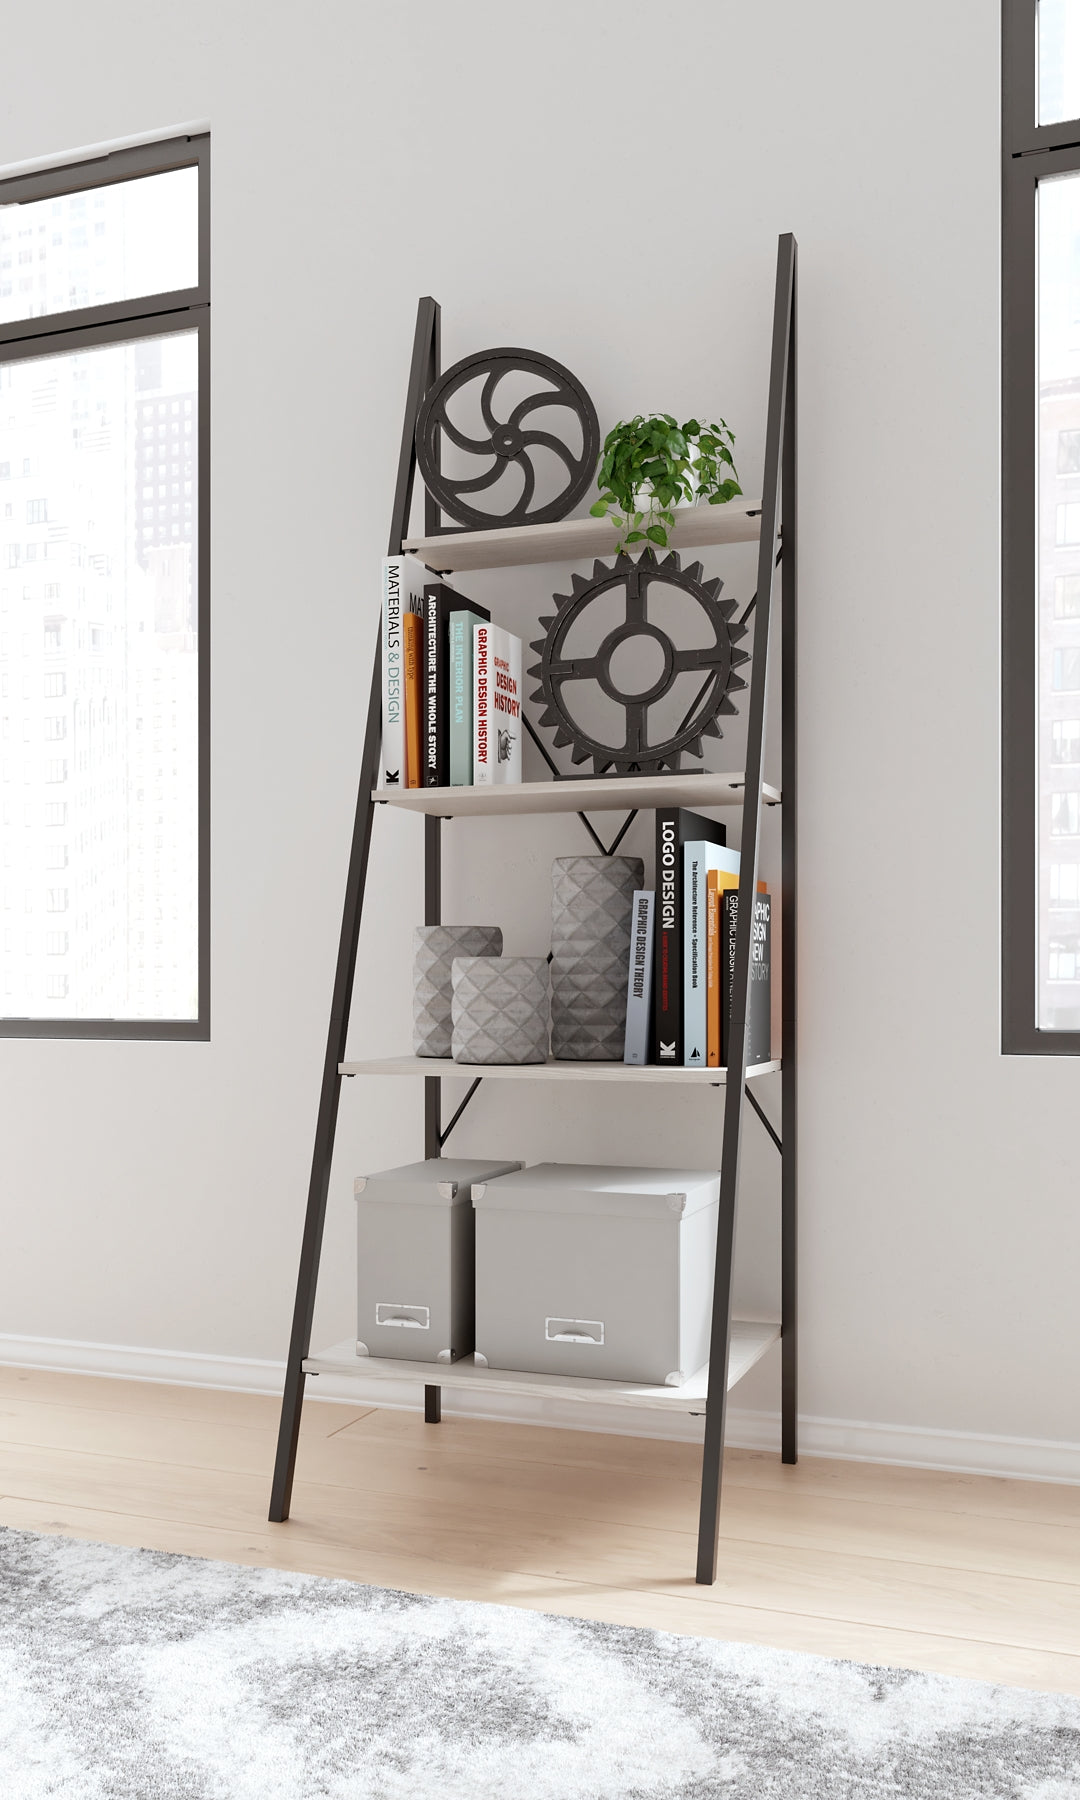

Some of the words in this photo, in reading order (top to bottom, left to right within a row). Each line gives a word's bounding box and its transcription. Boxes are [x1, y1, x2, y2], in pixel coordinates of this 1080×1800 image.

[387, 565, 400, 648] MATERIALS
[428, 595, 437, 672] ARCHITECTURE
[454, 622, 463, 641] THE
[388, 652, 400, 663] &
[455, 644, 463, 693] INTERIOR
[478, 628, 487, 675] GRAPHIC
[387, 667, 400, 723] DESIGN
[428, 674, 437, 693] THE
[478, 678, 487, 717] DESIGN
[496, 671, 517, 695] DESIGN
[428, 696, 437, 733] WHOLE
[455, 696, 464, 723] PLAN
[494, 691, 520, 718] HISTORY
[428, 735, 437, 769] STORY
[478, 719, 488, 764] HISTORY
[662, 821, 675, 866] LOGO
[638, 898, 649, 934] GRAPHIC
[662, 870, 675, 929] DESIGN
[729, 895, 738, 936] GRAPHIC
[708, 908, 716, 937] Essentials
[753, 922, 766, 941] SIGN
[635, 936, 646, 966] DESIGN
[691, 938, 699, 973] Specification
[633, 967, 645, 999] THEORY
[751, 962, 770, 981] STORY
